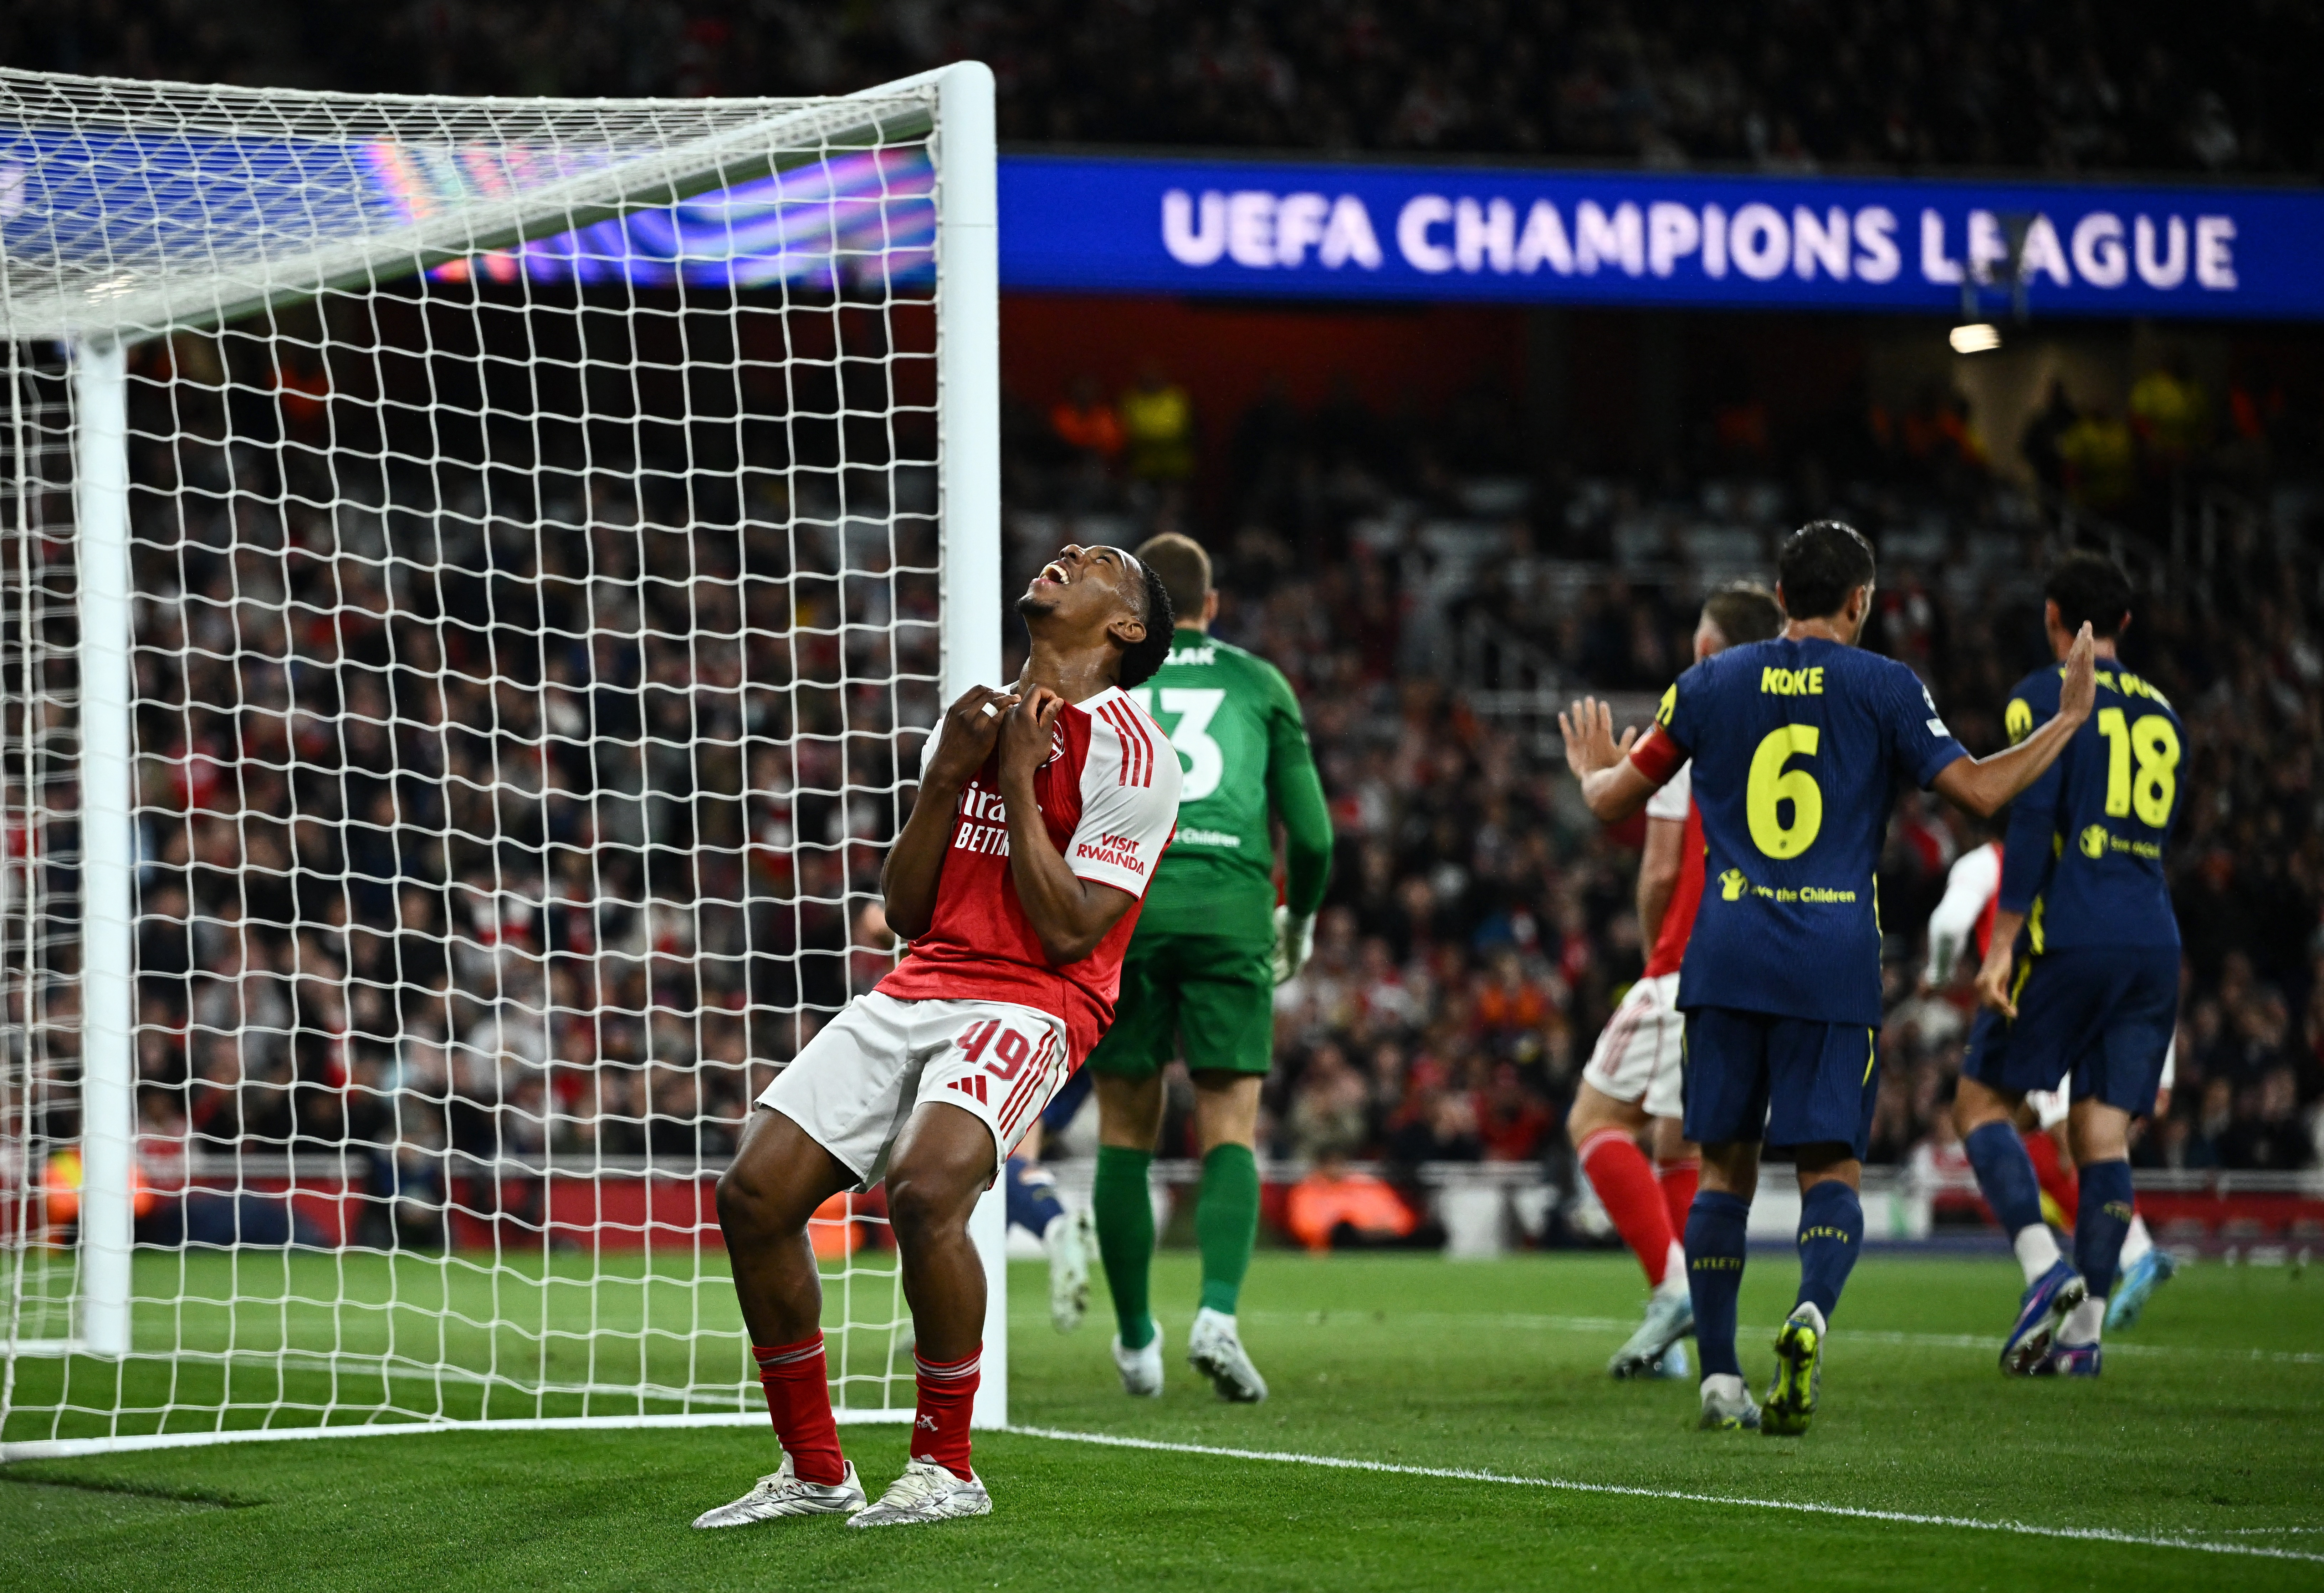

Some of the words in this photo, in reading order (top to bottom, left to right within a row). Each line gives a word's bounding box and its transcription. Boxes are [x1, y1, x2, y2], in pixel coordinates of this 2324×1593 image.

[1162, 190, 1382, 269] UEFA
[1396, 195, 1901, 282] CHAMPIONS
[1920, 210, 2235, 288] LEAGUE
[1761, 666, 1824, 696] KOKE
[2097, 707, 2181, 828] 18
[1746, 723, 1823, 860] 6
[1102, 832, 1139, 854] VISIT
[1076, 843, 1144, 876] RWANDA
[1776, 887, 1797, 902] the
[1800, 887, 1856, 903] Children
[956, 1018, 1031, 1081] 49
[1801, 1226, 1849, 1245] ATLETI
[1693, 1257, 1741, 1270] ATLETI
